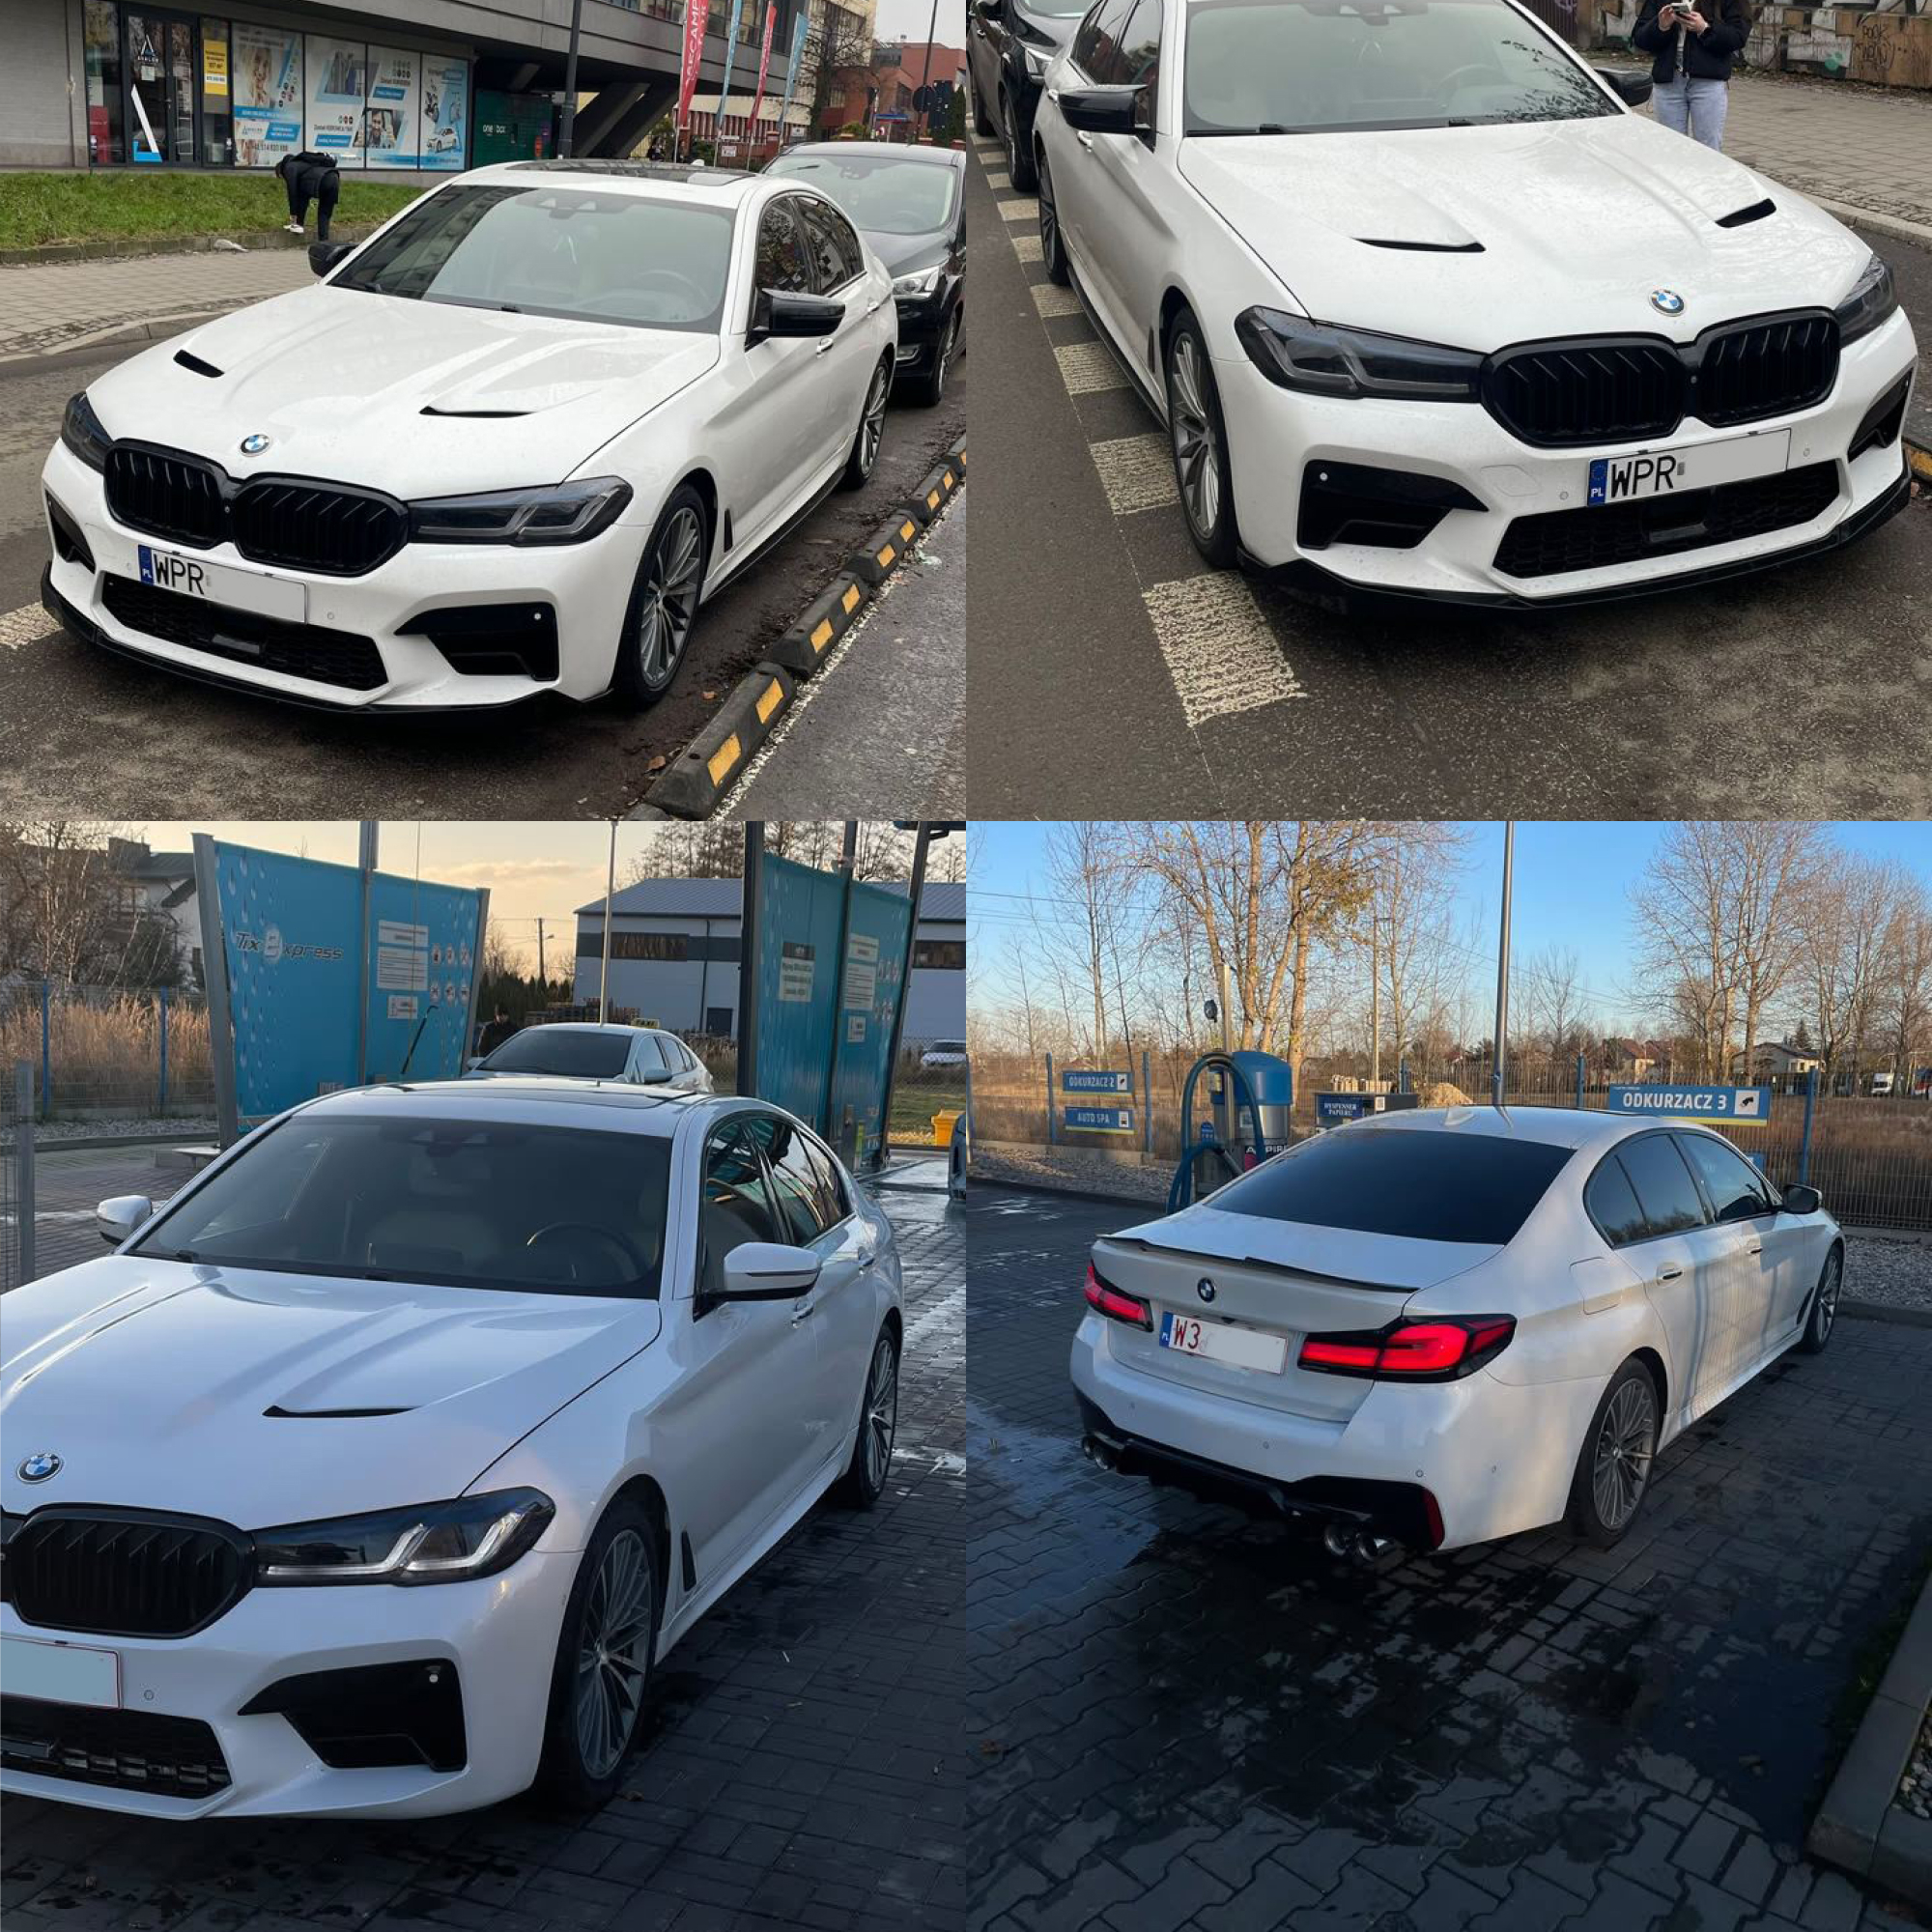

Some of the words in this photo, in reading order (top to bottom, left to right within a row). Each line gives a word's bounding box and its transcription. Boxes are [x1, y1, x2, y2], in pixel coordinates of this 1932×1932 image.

[1591, 487, 1604, 497] PL
[1611, 455, 1676, 497] WPR
[154, 554, 204, 595] WPR
[1068, 1076, 1108, 1088] ODKURZACZ
[1110, 1076, 1115, 1088] 2
[1623, 1093, 1713, 1110] ODKURZACZ
[1717, 1094, 1727, 1111] 3
[1077, 1112, 1095, 1122] AUTO
[1096, 1113, 1110, 1124] SPA
